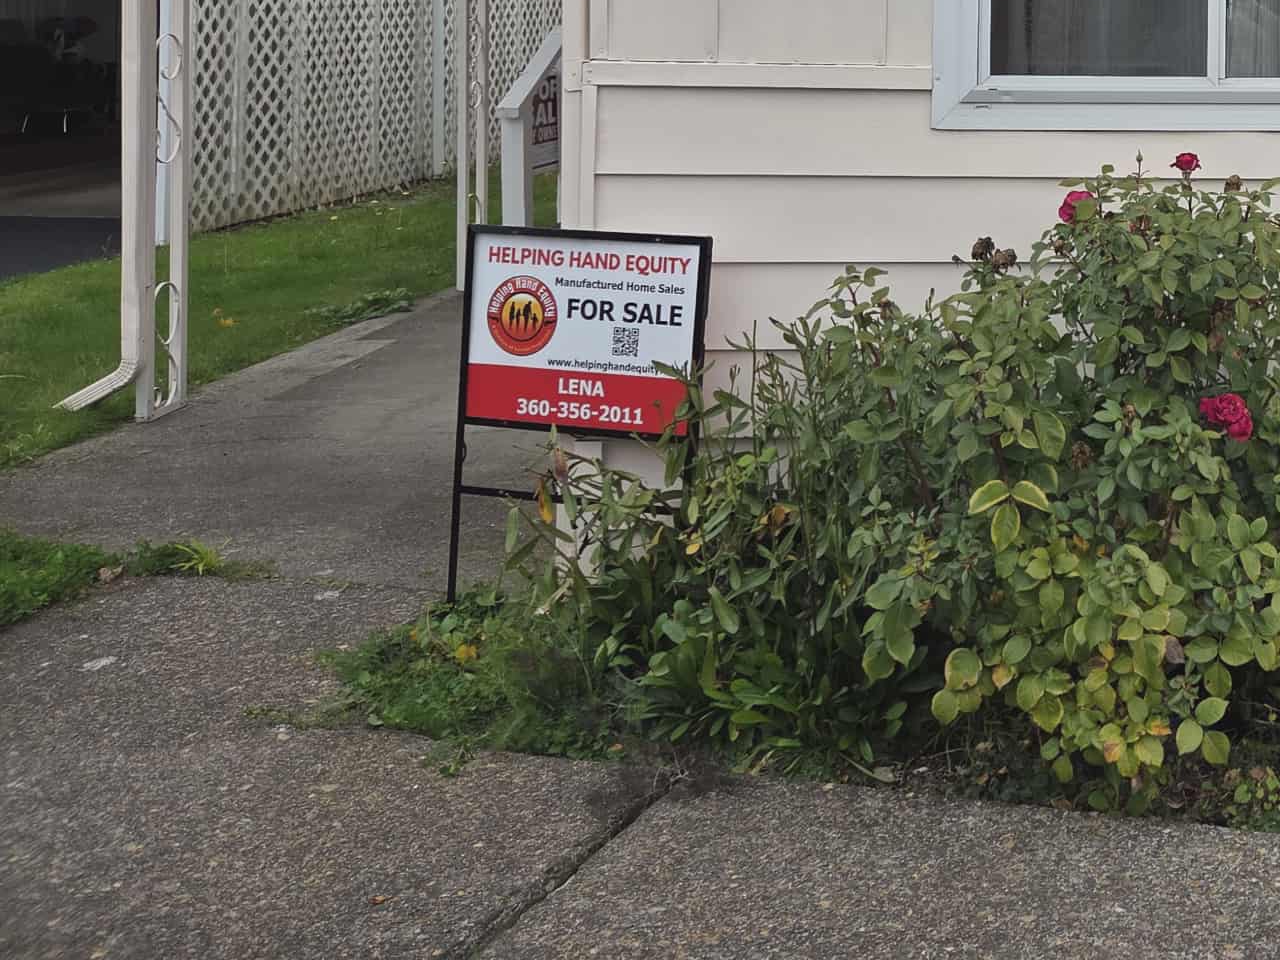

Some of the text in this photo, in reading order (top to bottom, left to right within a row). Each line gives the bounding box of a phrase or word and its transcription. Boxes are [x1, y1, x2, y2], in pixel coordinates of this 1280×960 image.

[488, 246, 692, 276] HELPING HAND EQUITY
[555, 277, 686, 296] Manufactured Home Sales
[566, 298, 684, 327] FOR SALE
[557, 377, 605, 398] LENA
[516, 397, 644, 425] 360-356-2011
